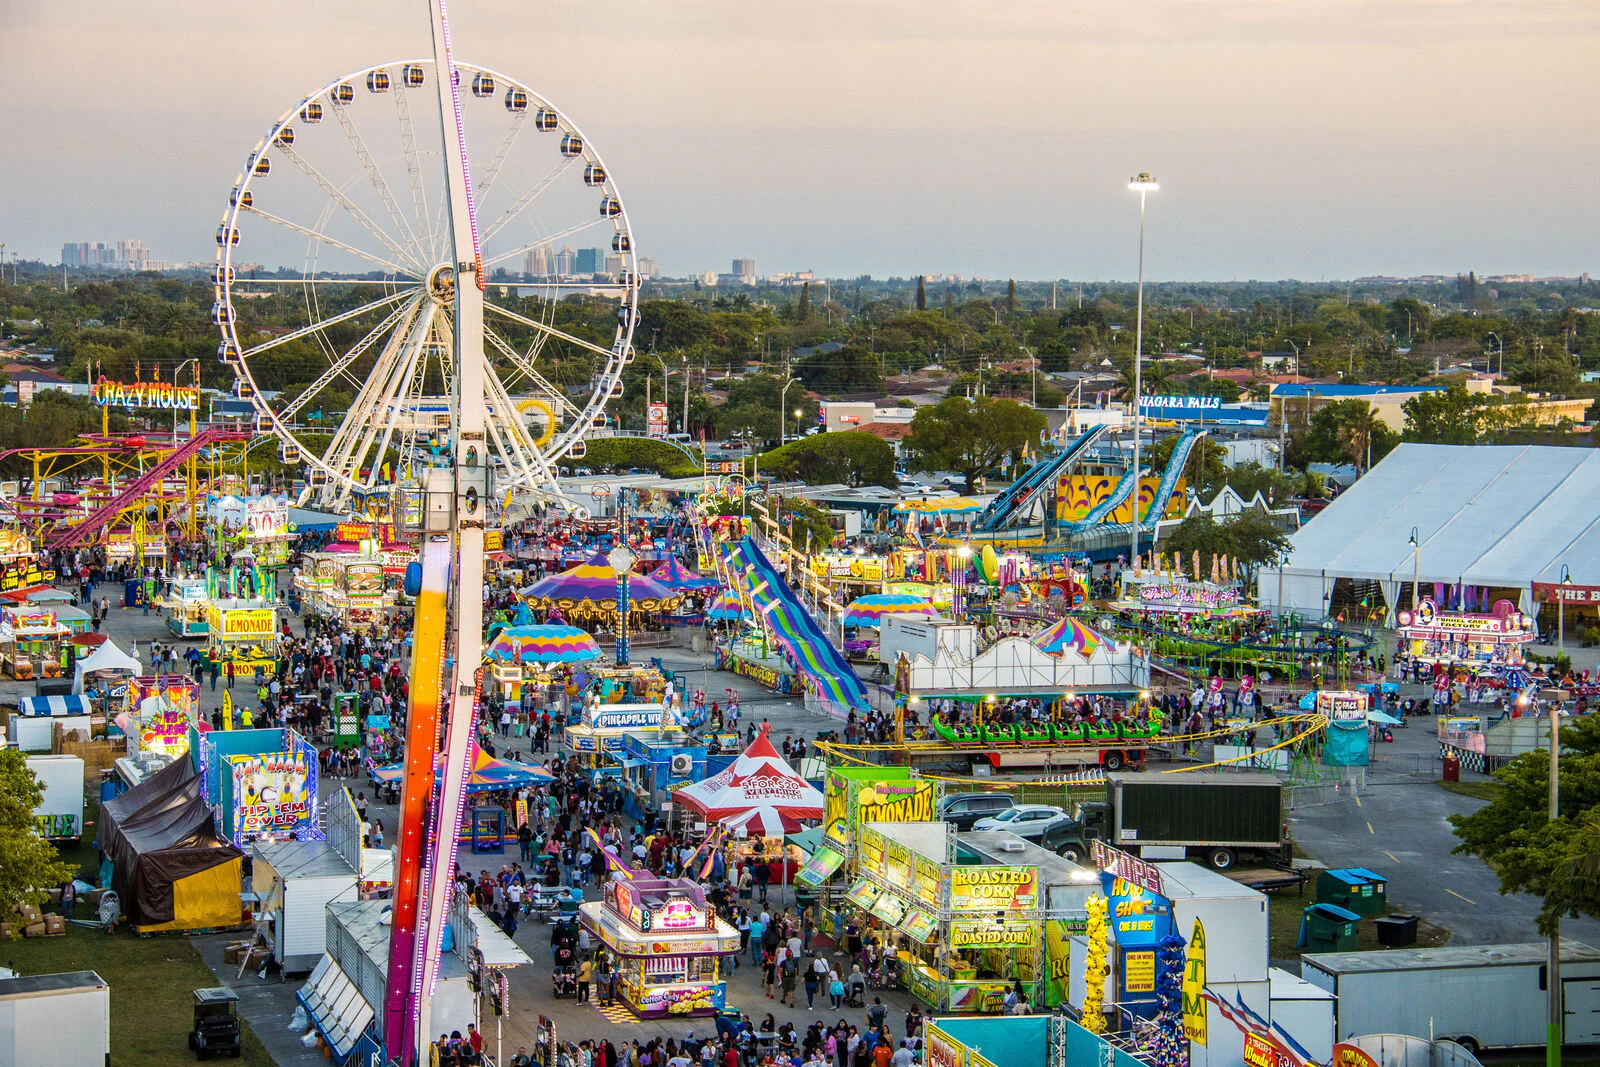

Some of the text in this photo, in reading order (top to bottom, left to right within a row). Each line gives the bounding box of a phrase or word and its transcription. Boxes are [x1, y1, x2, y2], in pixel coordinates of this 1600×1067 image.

[95, 382, 198, 410] CRAZY MOUSE
[1140, 396, 1220, 409] NIAGARA FALLS
[135, 585, 143, 605] ATM
[1555, 589, 1586, 600] THE
[225, 619, 273, 632] LEMONADE
[1441, 621, 1481, 629] FACTORY
[223, 664, 273, 675] LMONDE
[744, 663, 776, 684] FUN SLIDE
[1342, 701, 1358, 710] FACE
[601, 713, 647, 726] PINEAPPLE
[1334, 710, 1366, 719] PAINTING
[742, 780, 799, 790] 5 FOR $20
[241, 802, 305, 816] TIP 'EM
[860, 783, 932, 823] LEMONADE
[245, 814, 298, 826] OVER
[956, 870, 1032, 886] ROASTED
[971, 884, 1016, 899] CORN
[668, 904, 692, 915] POP
[955, 931, 1032, 945] ROASTED CORN
[1182, 922, 1205, 1018] ATM
[641, 995, 663, 1005] Cotton
